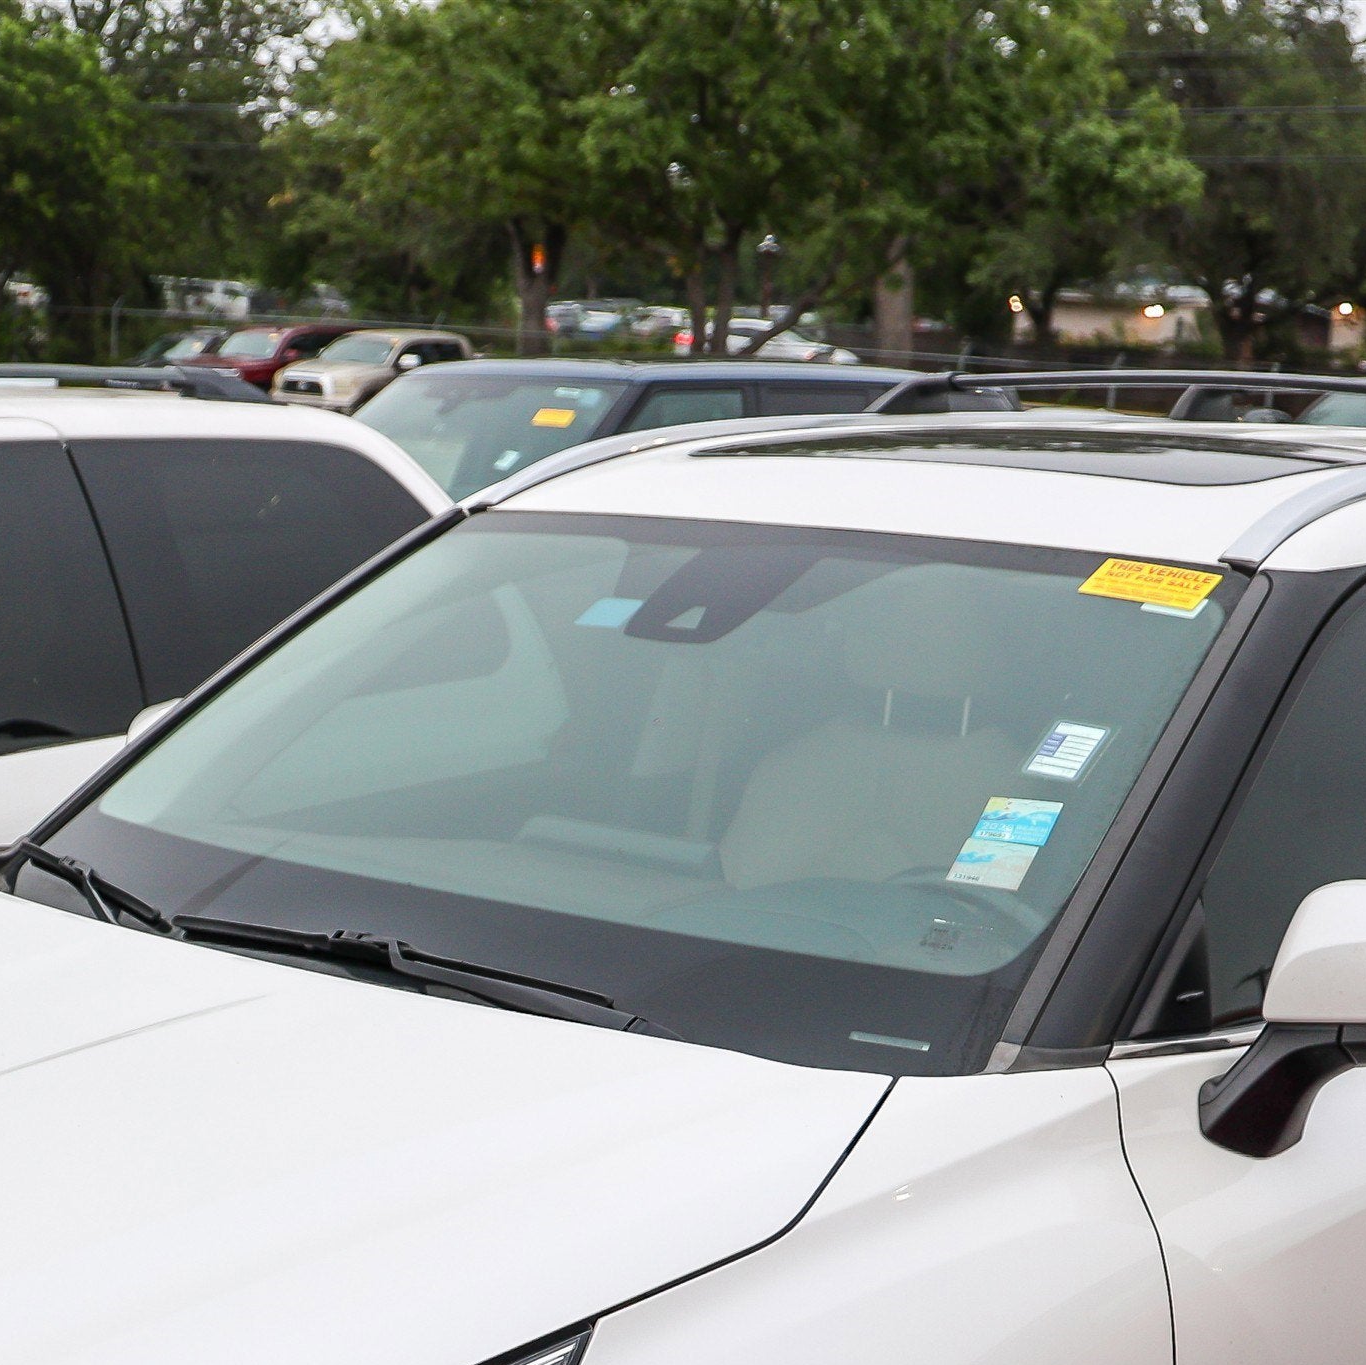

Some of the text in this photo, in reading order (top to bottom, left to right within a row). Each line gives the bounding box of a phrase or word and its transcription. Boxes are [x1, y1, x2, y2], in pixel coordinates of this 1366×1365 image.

[1106, 570, 1202, 591] NOT FOR SALE
[1110, 561, 1217, 584] THIS VEHICLE
